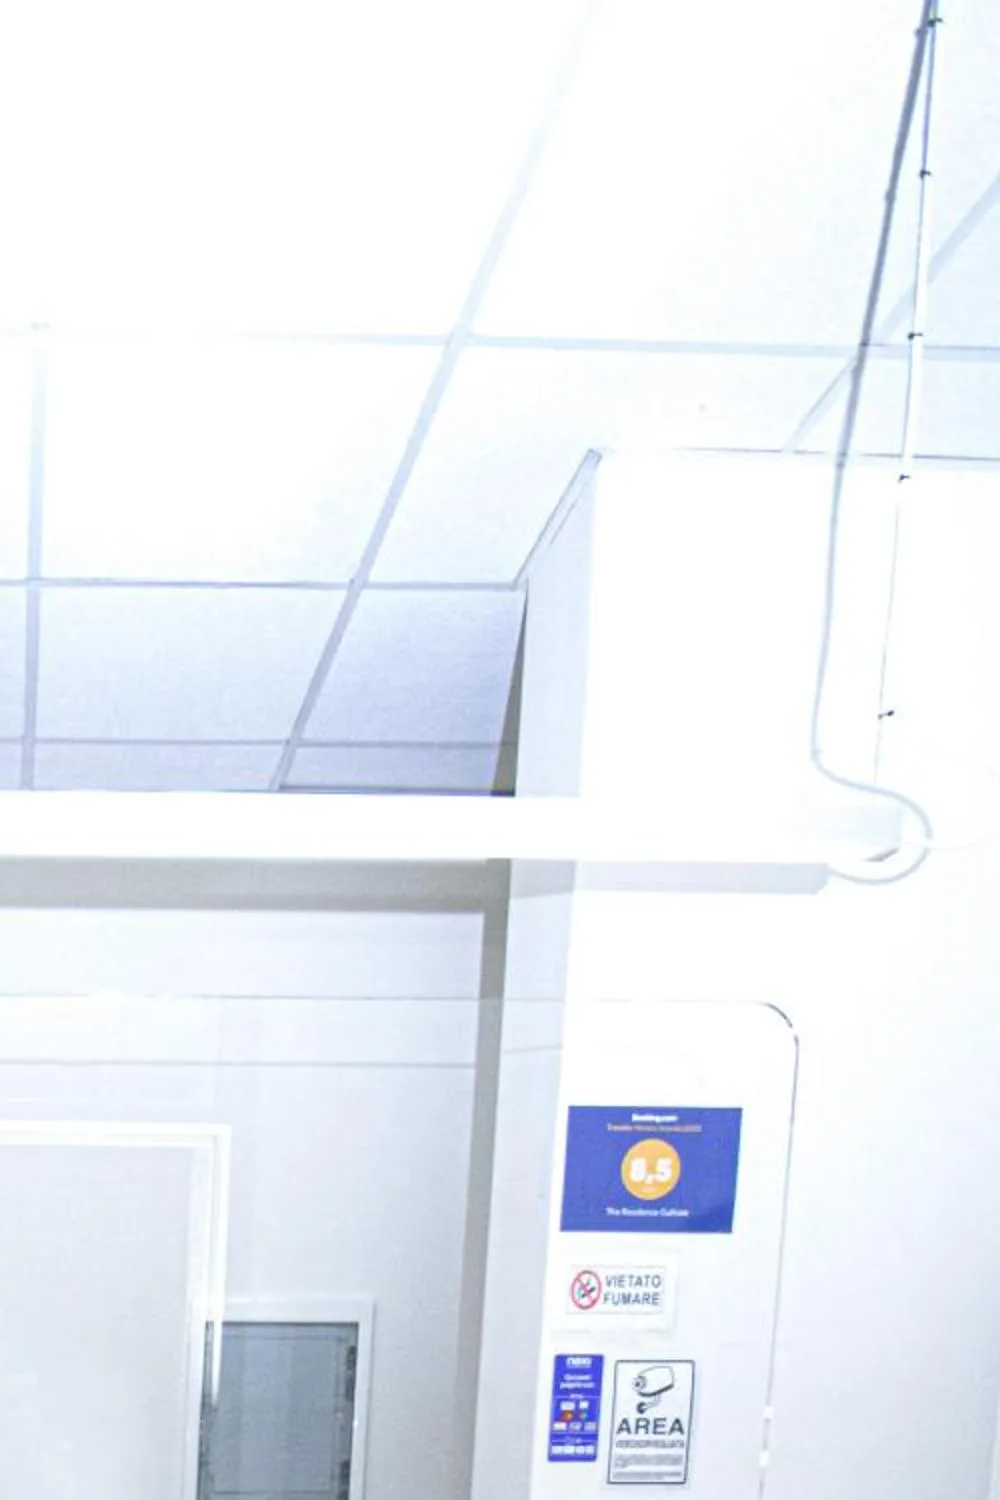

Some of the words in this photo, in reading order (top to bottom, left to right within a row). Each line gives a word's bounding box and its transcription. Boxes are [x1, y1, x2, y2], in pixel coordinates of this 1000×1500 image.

[605, 1274, 662, 1288] VIETATO
[603, 1292, 661, 1306] FUMARE
[616, 1418, 685, 1435] AREA
